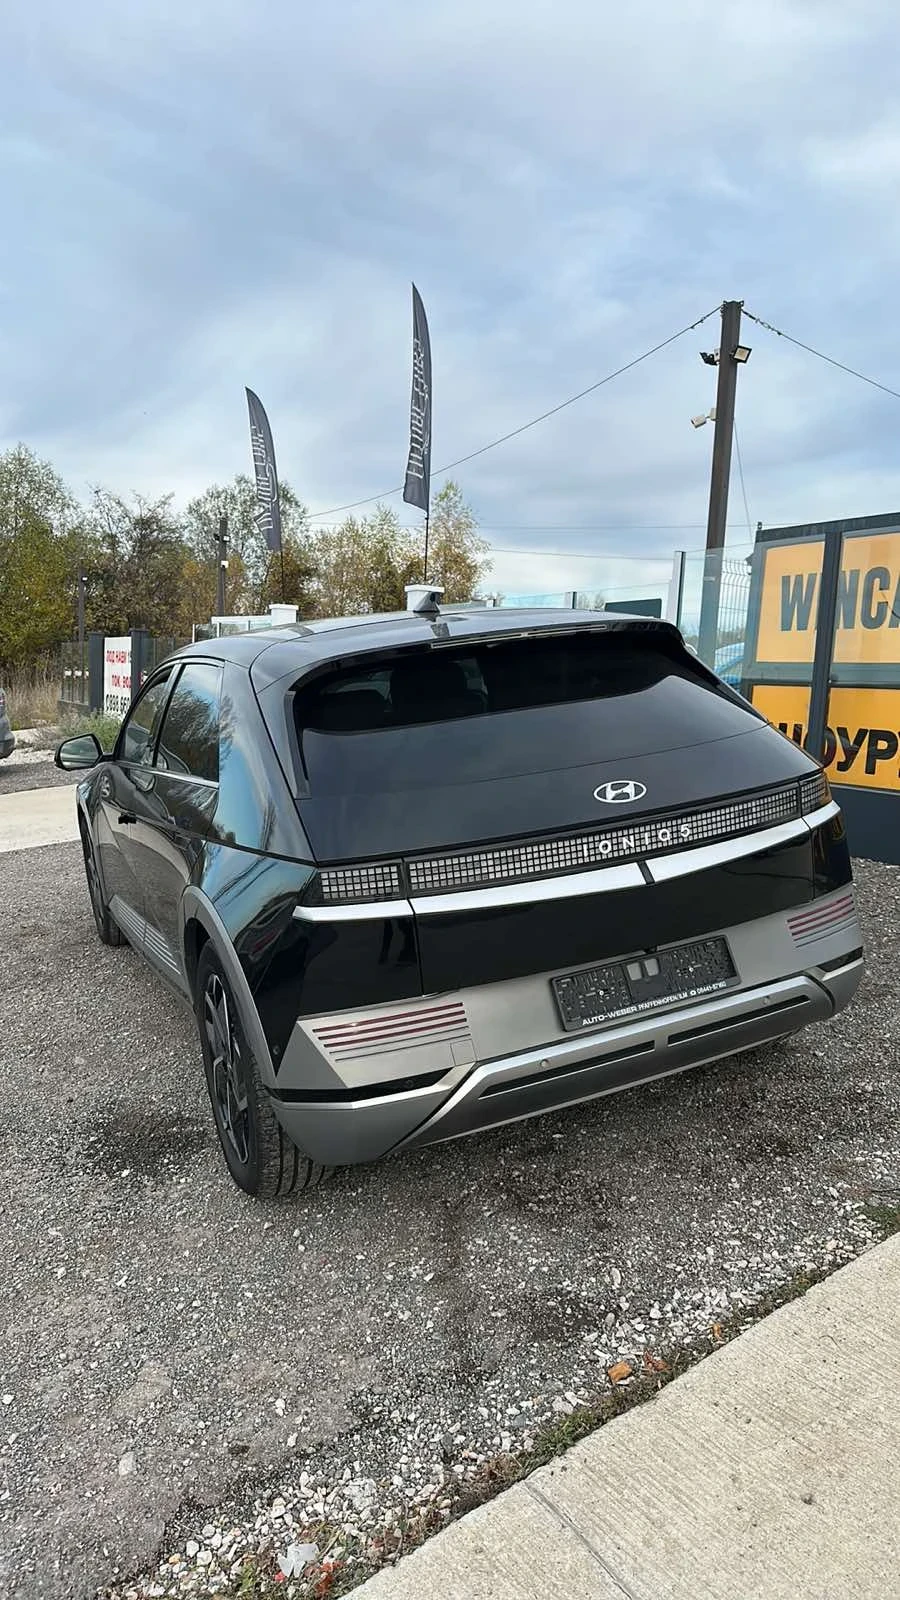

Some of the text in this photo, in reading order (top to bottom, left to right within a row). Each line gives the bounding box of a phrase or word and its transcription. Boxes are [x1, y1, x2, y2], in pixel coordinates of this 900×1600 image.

[780, 566, 900, 632] WNC
[583, 823, 690, 857] IONIQ 5
[582, 1004, 638, 1026] AUTO-WEBER
